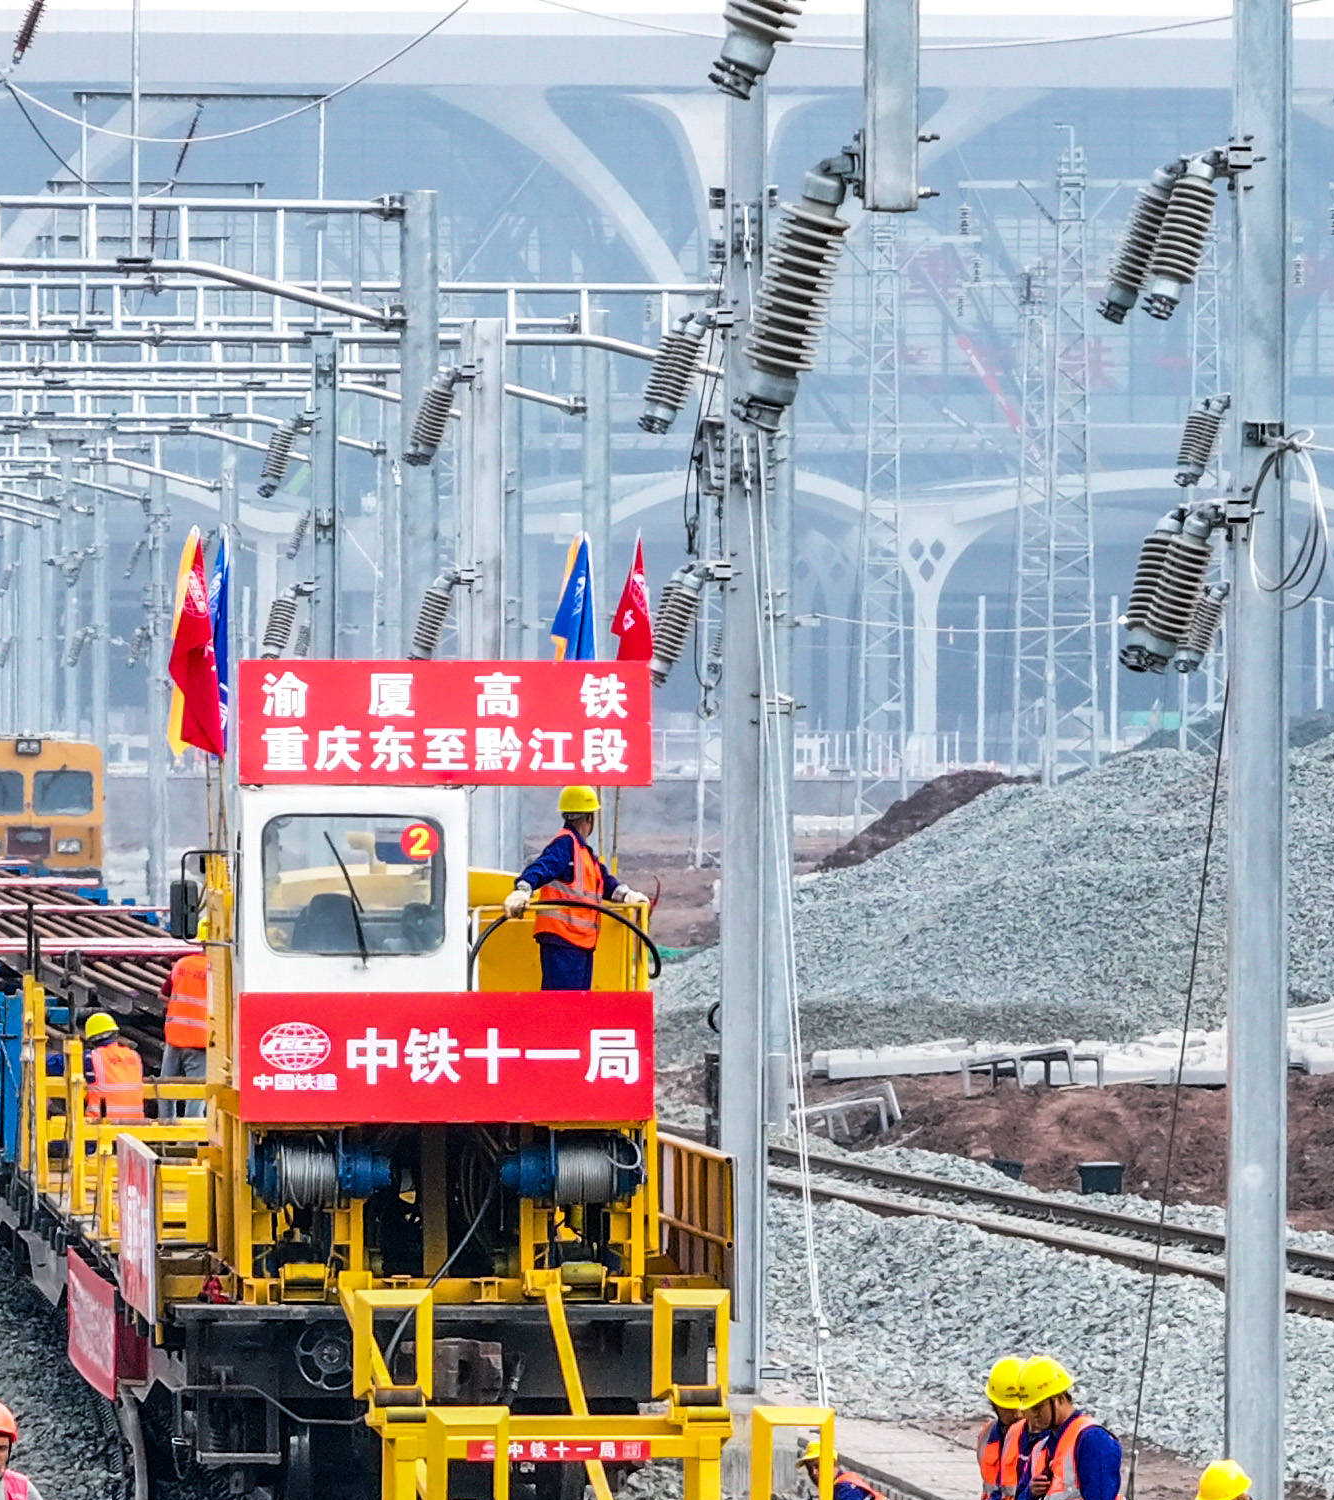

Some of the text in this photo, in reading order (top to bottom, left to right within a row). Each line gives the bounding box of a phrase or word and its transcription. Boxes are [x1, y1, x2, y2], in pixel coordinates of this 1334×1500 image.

[261, 672, 628, 719] 渝厦高铁
[261, 725, 628, 773] 重庆东至黔江段
[409, 828, 431, 856] 2
[346, 1027, 640, 1085] 中铁十一局
[252, 1073, 338, 1091] 中国铁建
[508, 1441, 616, 1459] 中铁十一局
